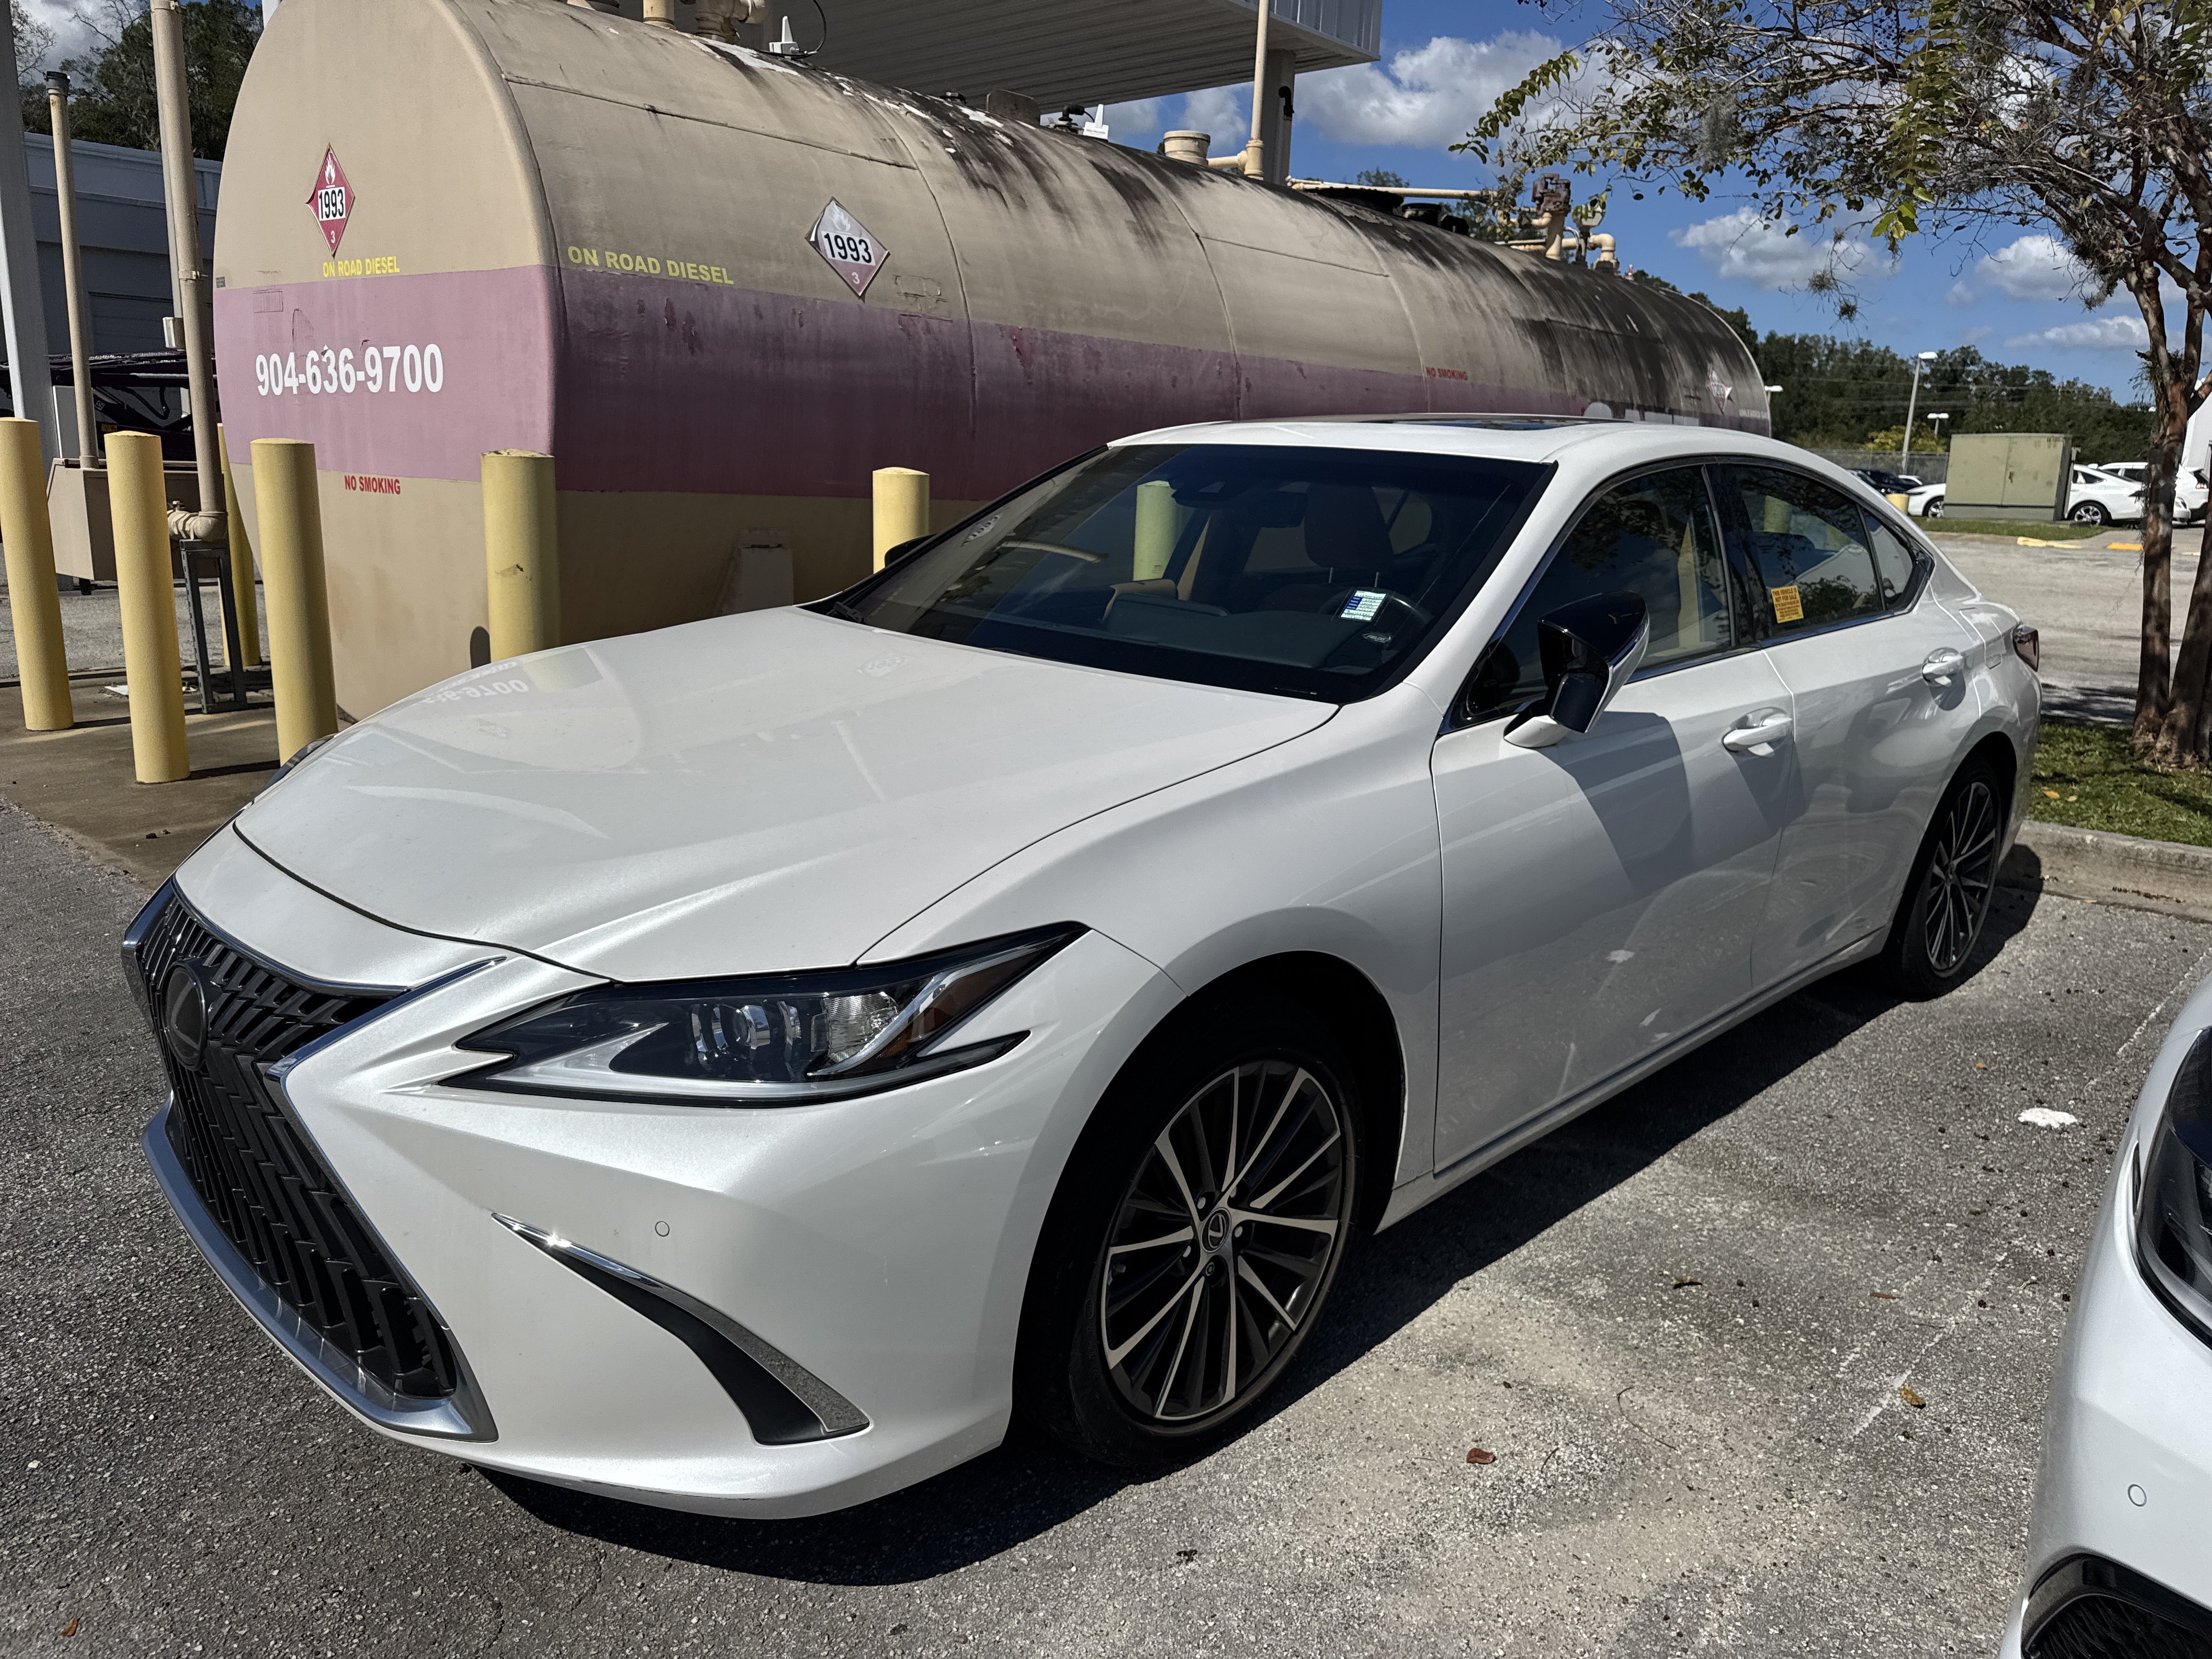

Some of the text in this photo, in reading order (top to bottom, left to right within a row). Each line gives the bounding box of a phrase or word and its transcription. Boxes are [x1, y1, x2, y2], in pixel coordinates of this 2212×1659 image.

[319, 189, 344, 219] 1993
[331, 230, 336, 244] 3
[823, 233, 872, 263] 1993
[323, 256, 400, 278] ON ROAD DIESEL
[567, 246, 734, 285] ON ROAD DIESEL
[851, 272, 860, 284] 3
[256, 343, 443, 396] 904-636-9700
[1425, 366, 1468, 381] NO SMOKING
[344, 475, 400, 494] NO SMOKING
